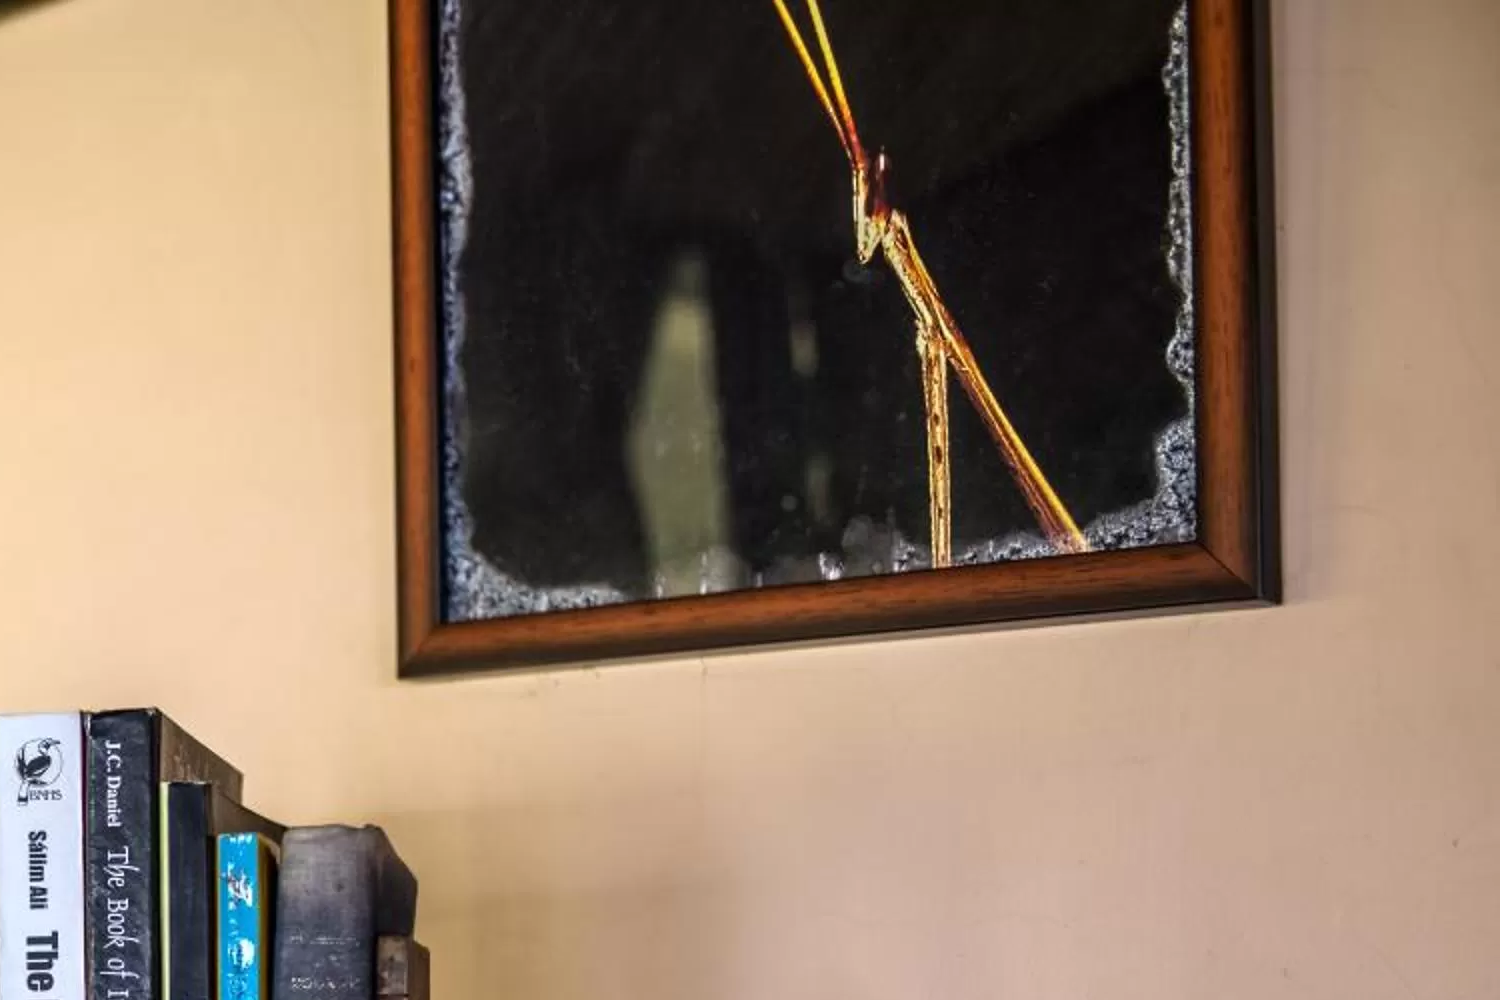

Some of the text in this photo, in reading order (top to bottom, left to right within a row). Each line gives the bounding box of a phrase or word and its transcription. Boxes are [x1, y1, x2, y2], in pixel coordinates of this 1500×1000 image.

[105, 739, 123, 828] J.C. Daniel
[103, 845, 141, 888] The
[103, 898, 140, 949] Book
[26, 930, 59, 992] The
[100, 957, 140, 979] of
